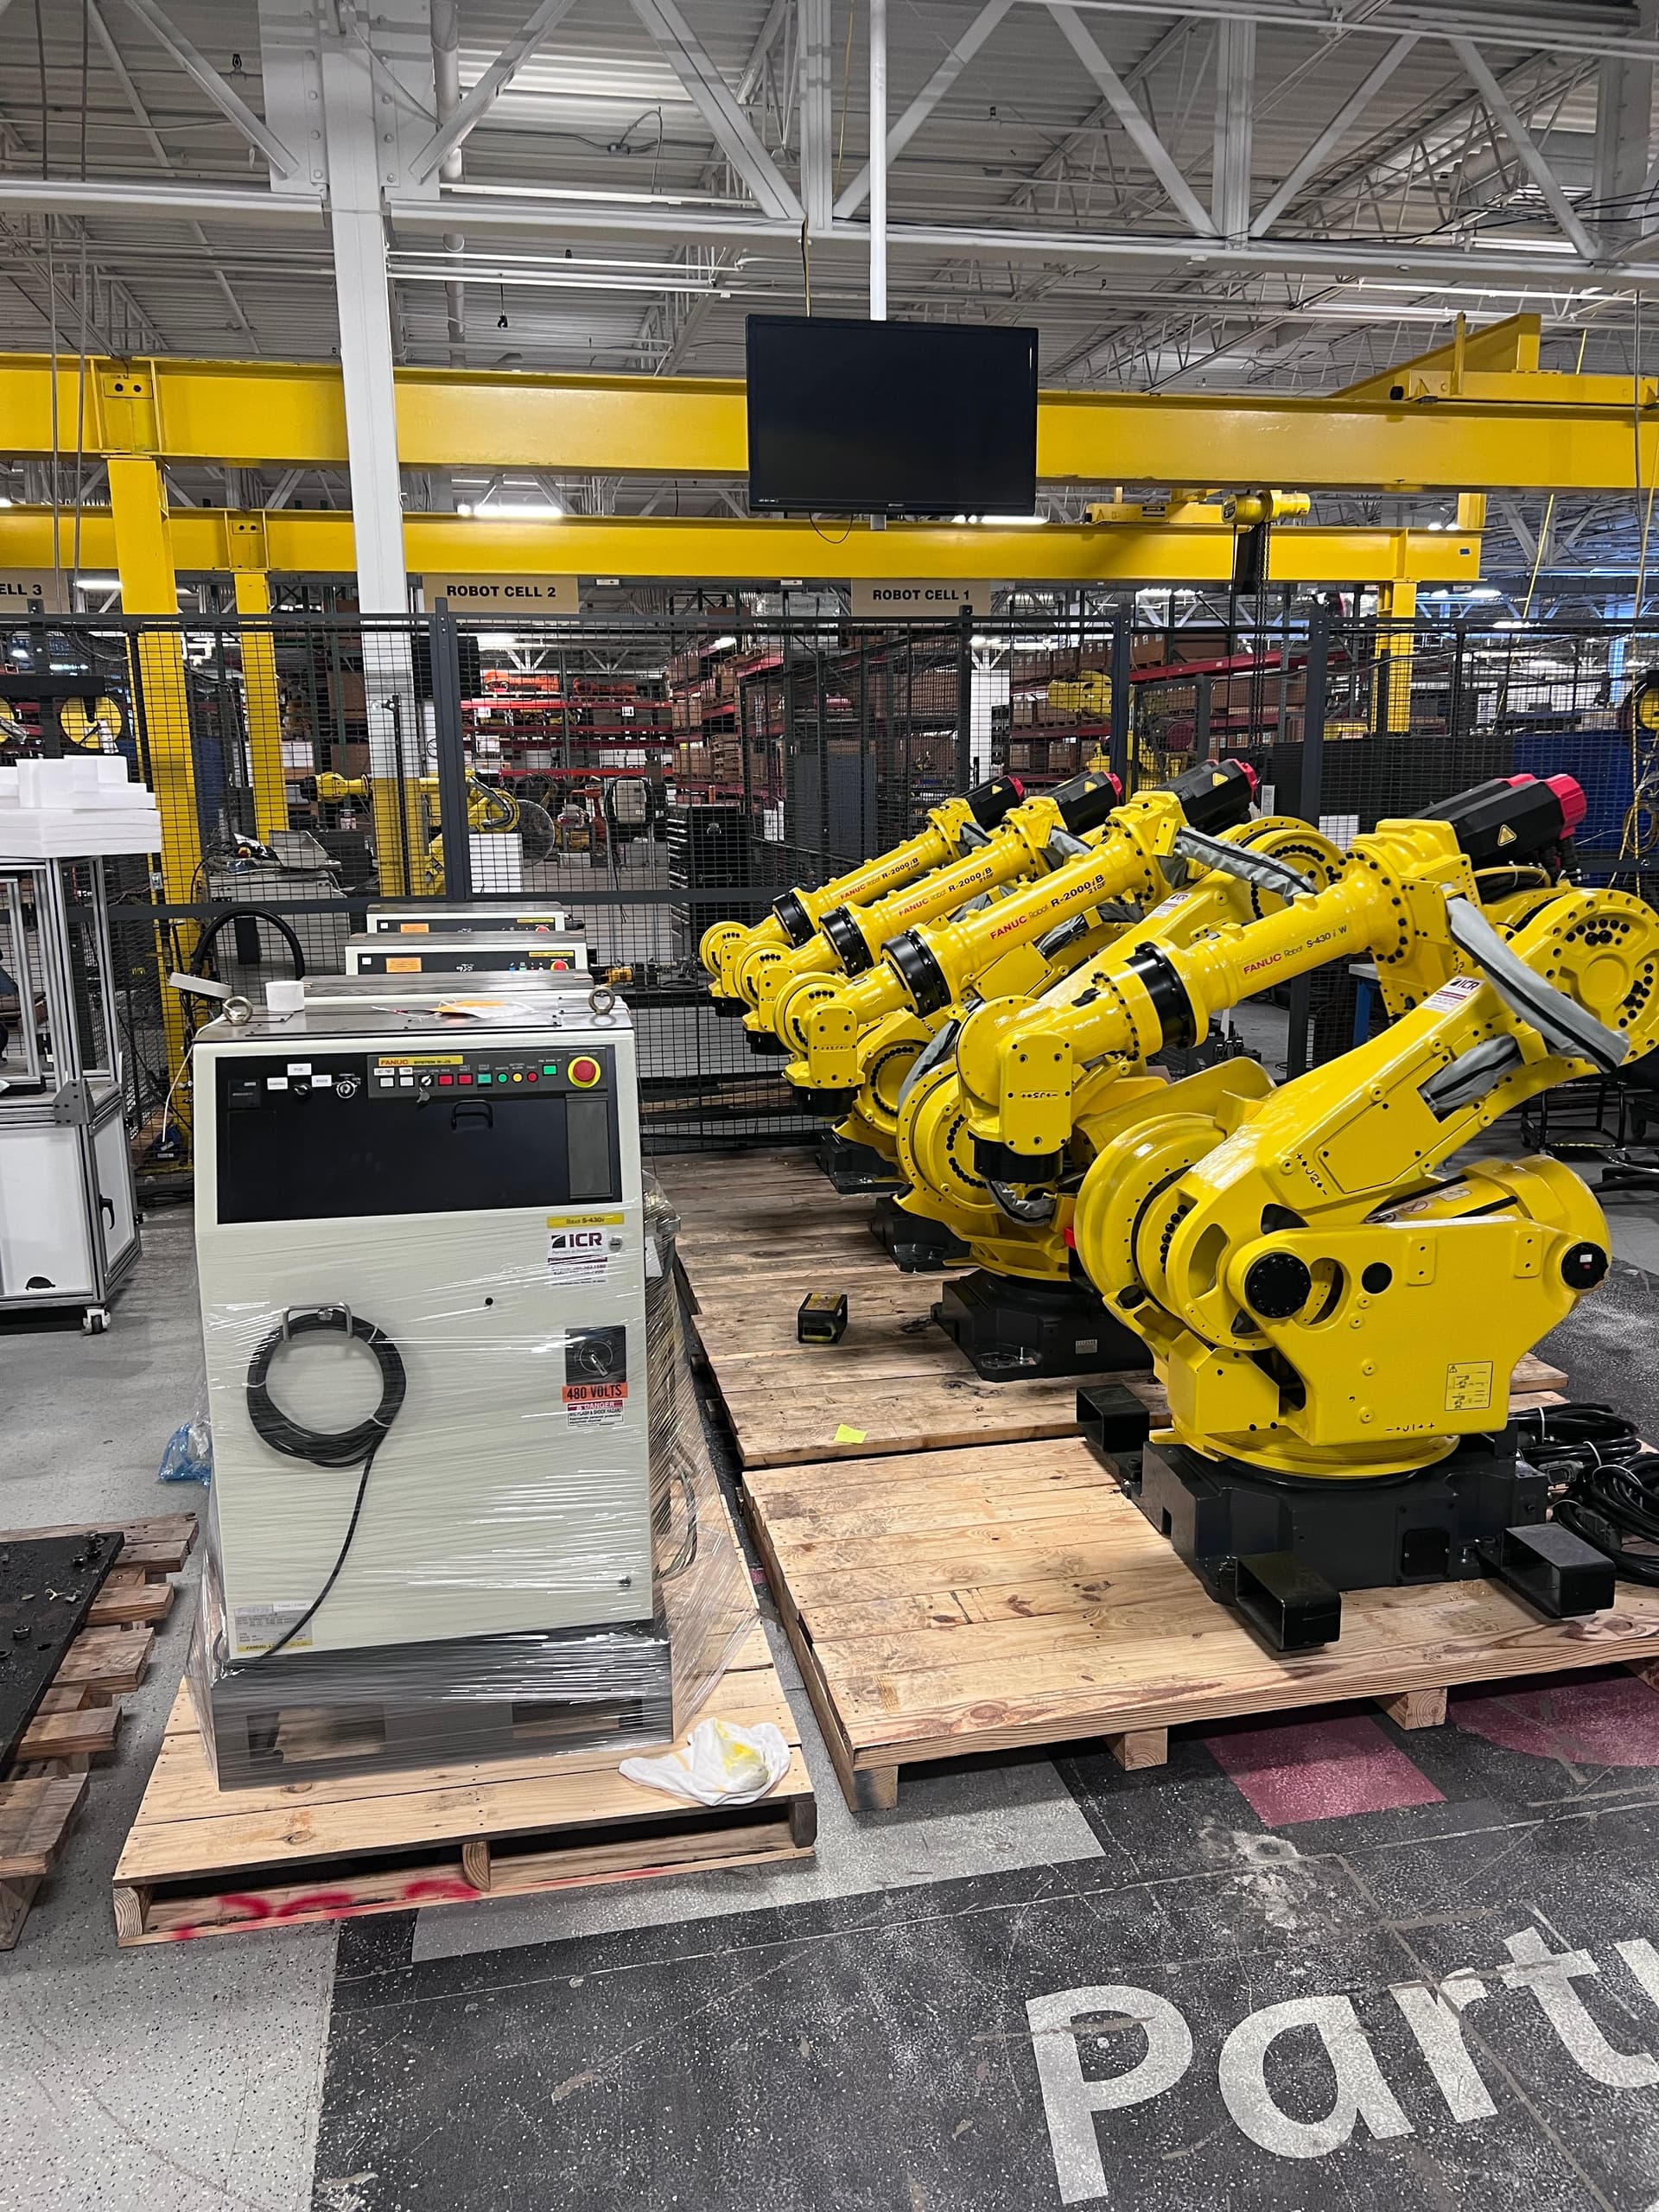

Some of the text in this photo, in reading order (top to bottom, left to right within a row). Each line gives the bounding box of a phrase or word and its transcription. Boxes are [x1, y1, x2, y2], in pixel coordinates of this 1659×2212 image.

[32, 584, 42, 596] 3
[447, 585, 556, 598] ROBOT CELL 2
[873, 589, 969, 601] ROBOT CELL 1
[840, 883, 866, 899] FANUC
[899, 899, 930, 917] FANUC
[948, 867, 993, 893] R-2000iB
[1087, 881, 1107, 894] 210F
[989, 874, 1105, 940] FANUC Robot R-2000iB
[1243, 953, 1281, 975] FANUC
[1283, 945, 1303, 958] Robot
[1338, 925, 1347, 934] W
[1458, 979, 1480, 990] ICR
[569, 1232, 603, 1249] ICR
[567, 1384, 622, 1400] 480 VOLTS
[585, 1401, 615, 1410] DANGER
